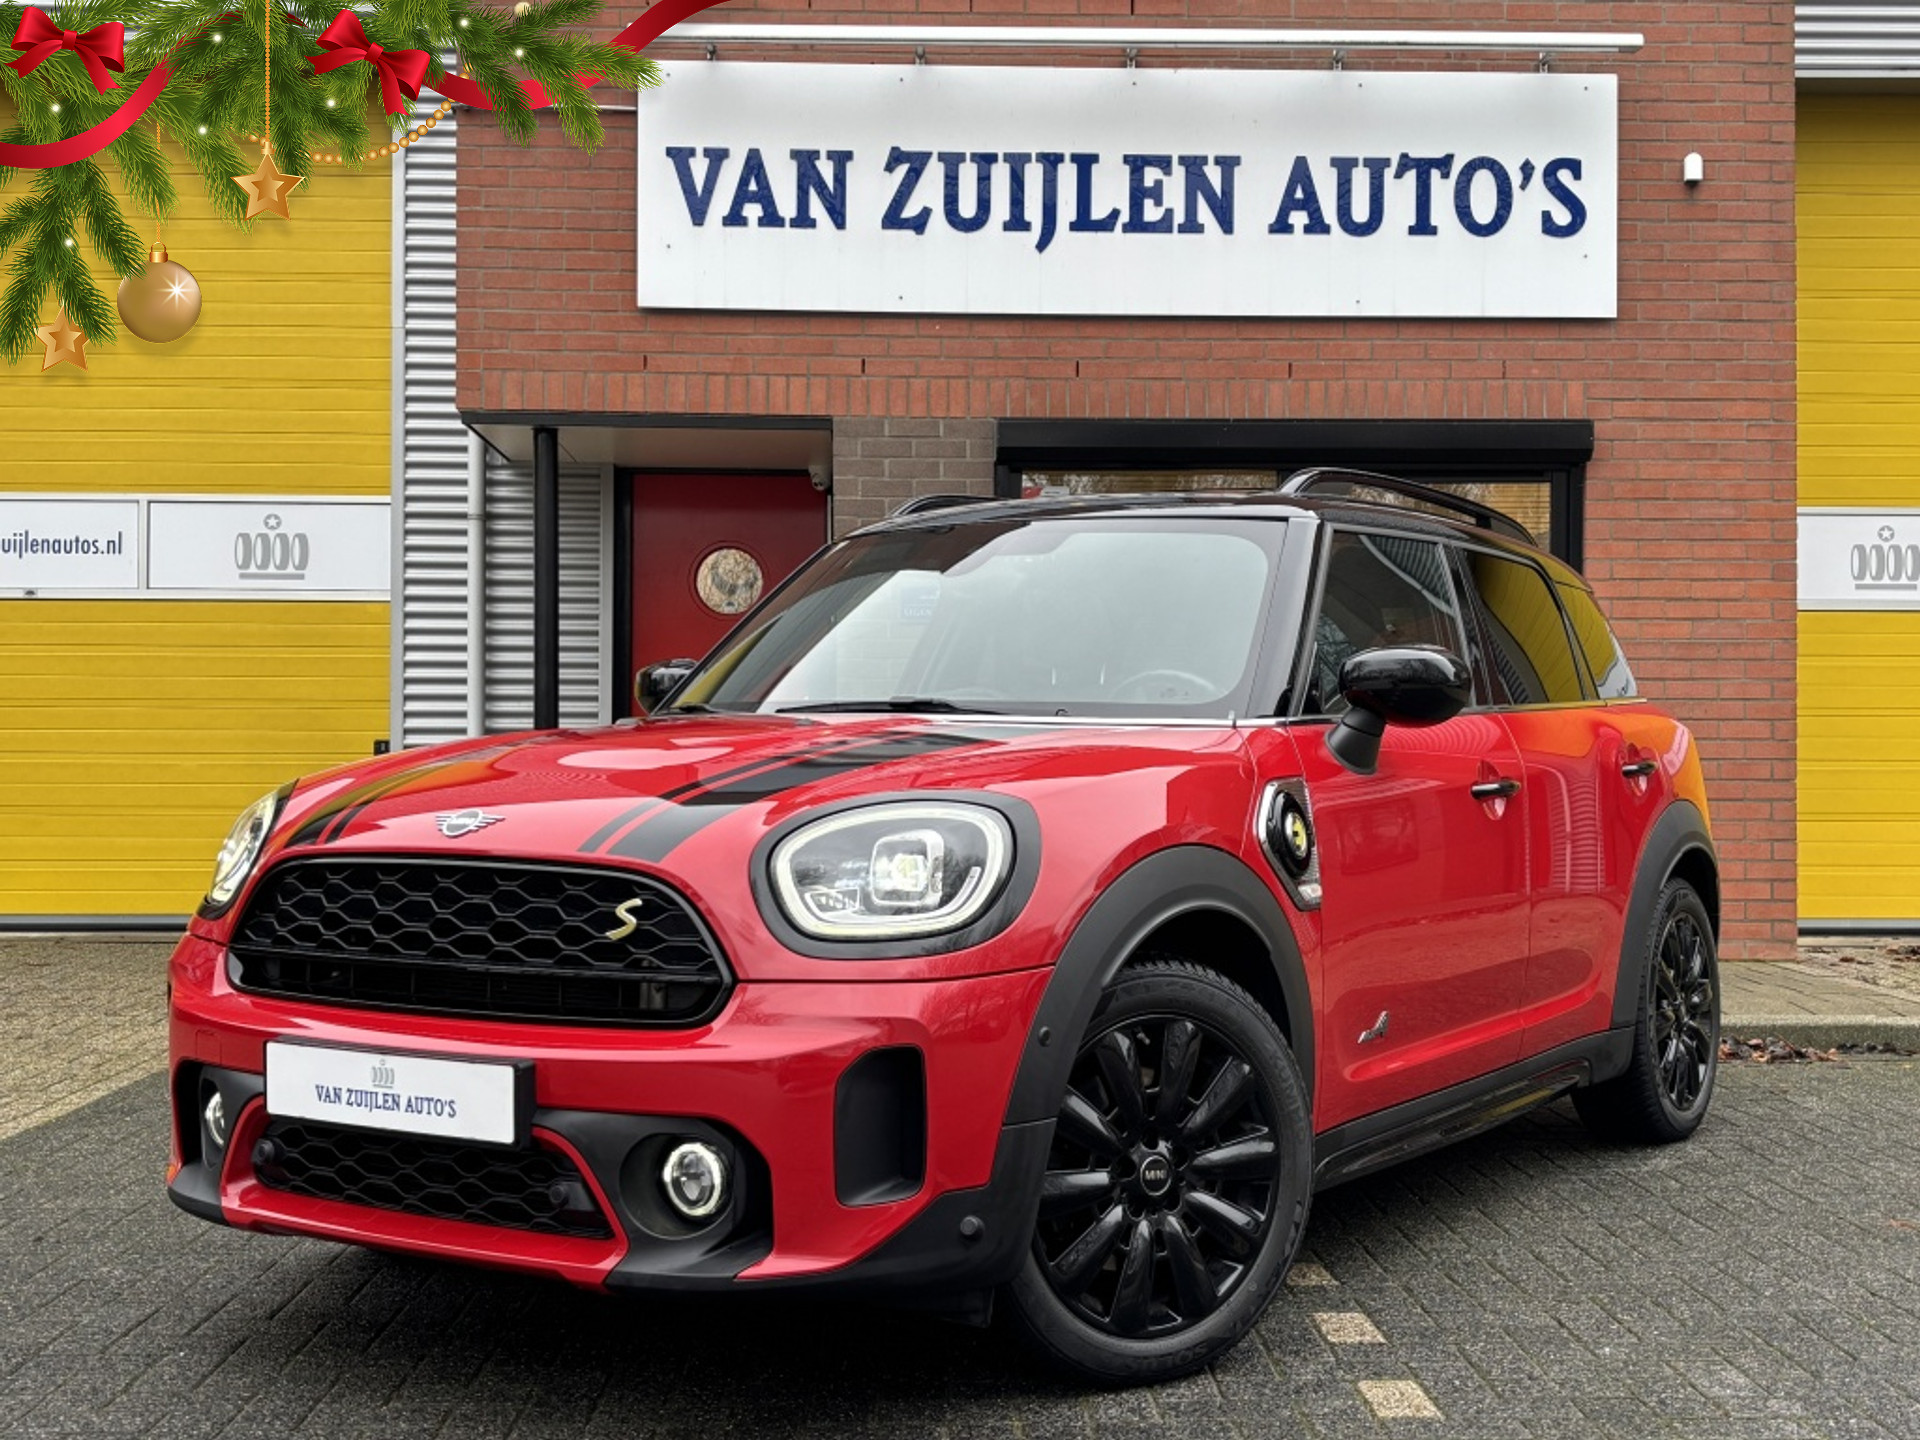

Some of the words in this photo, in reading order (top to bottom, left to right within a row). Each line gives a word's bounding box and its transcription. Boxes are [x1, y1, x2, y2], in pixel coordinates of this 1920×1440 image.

[665, 146, 853, 230] VAN
[881, 146, 1241, 254] ZUIJLEN
[1268, 153, 1587, 239] AUTO'S
[315, 1084, 342, 1104] VAN
[345, 1088, 400, 1113] ZUIJLEN
[404, 1096, 456, 1119] AUTO'S
